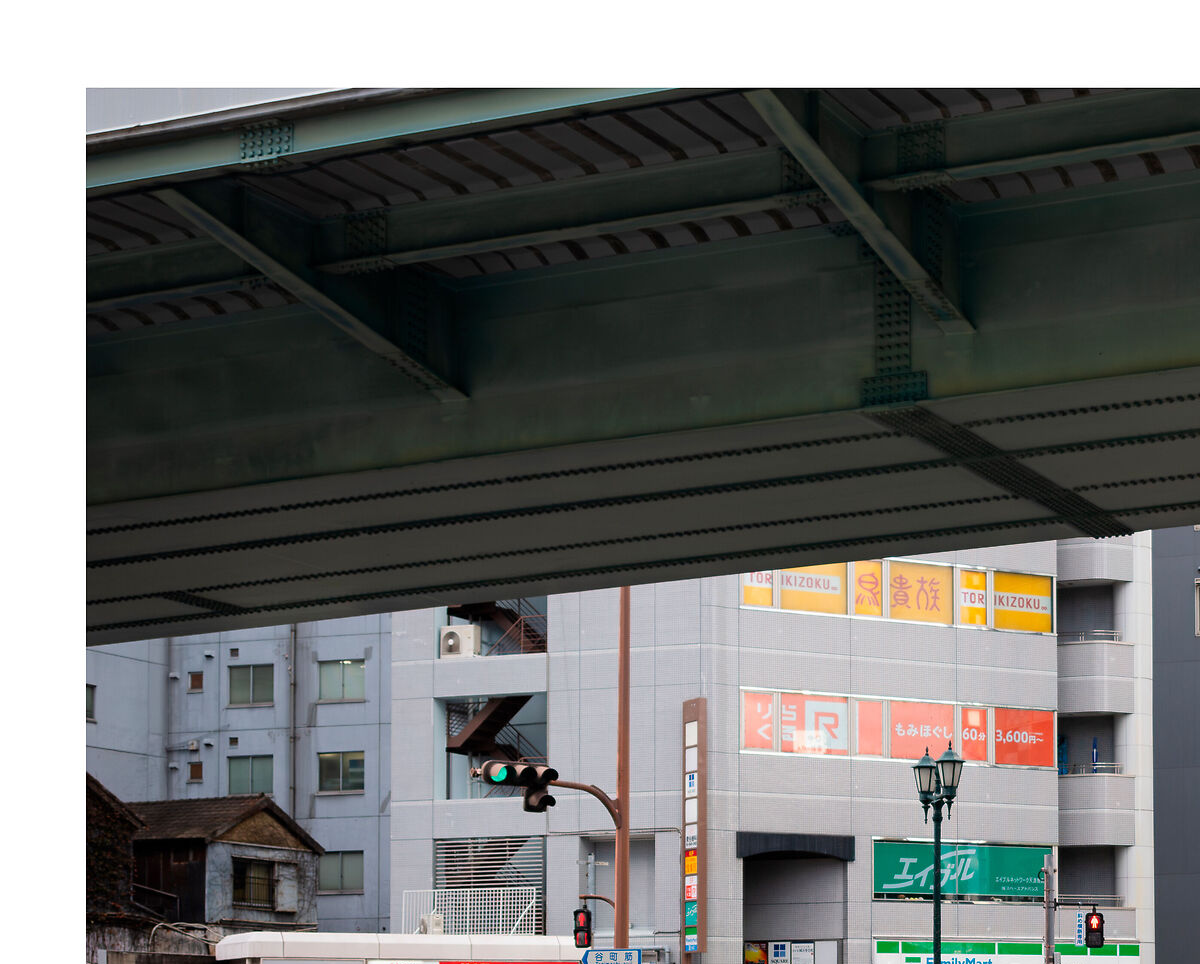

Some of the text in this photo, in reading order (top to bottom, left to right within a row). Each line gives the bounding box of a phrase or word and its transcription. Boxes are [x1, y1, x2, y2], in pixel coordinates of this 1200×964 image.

[895, 722, 953, 739] もみほぐし
[595, 952, 633, 962] 谷町筋
